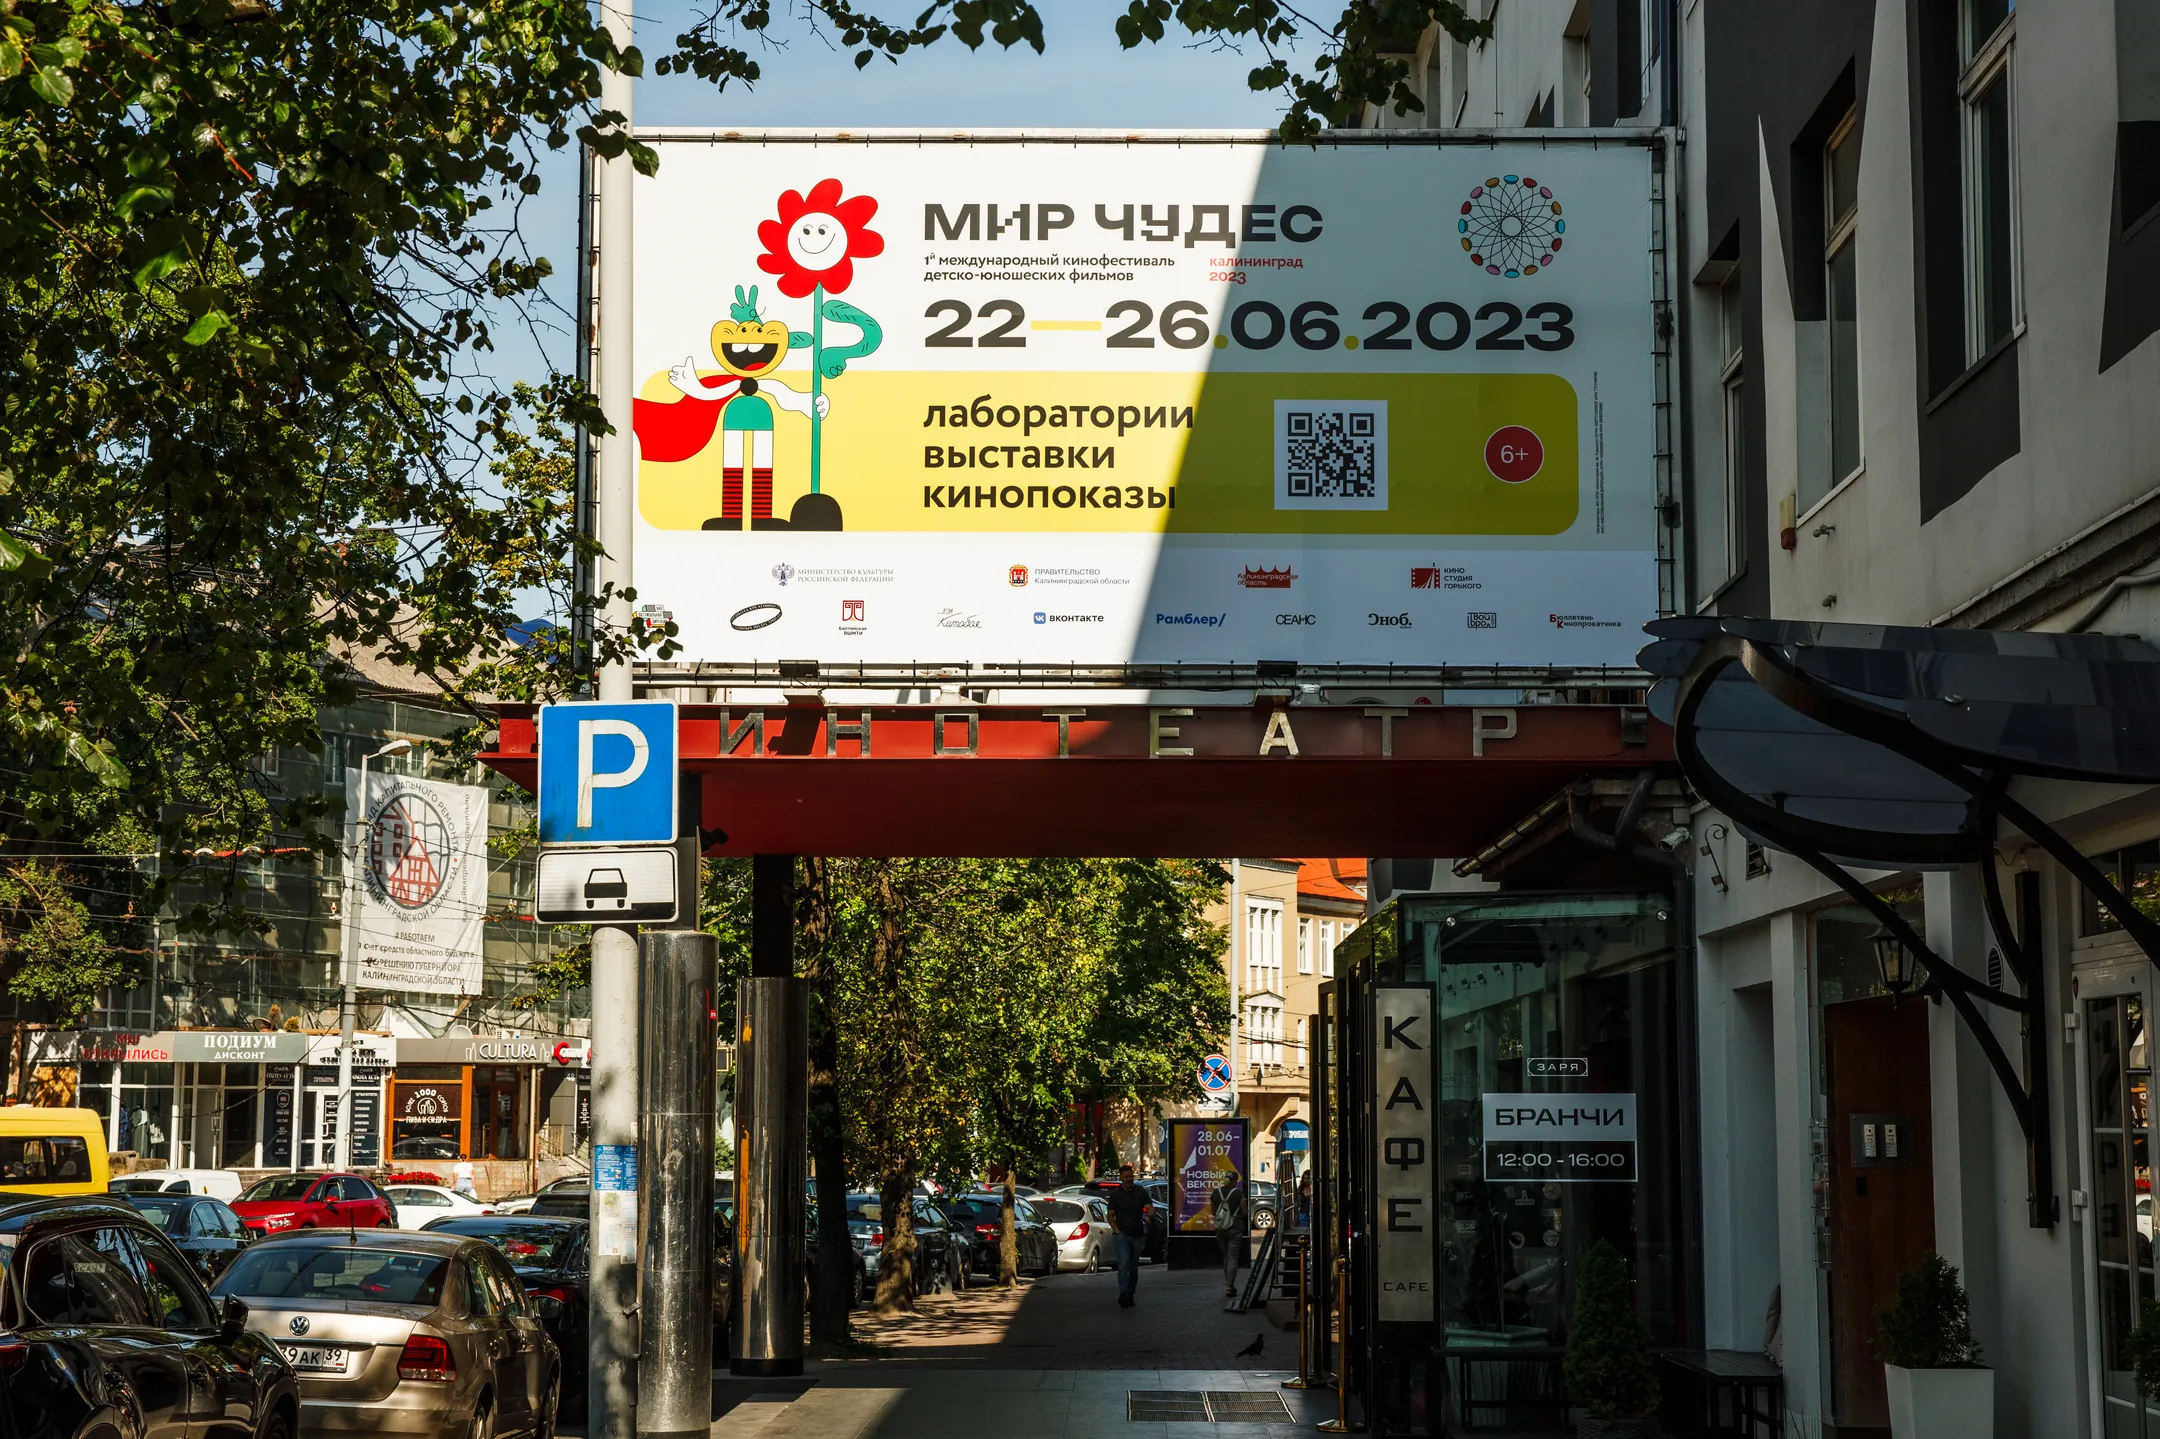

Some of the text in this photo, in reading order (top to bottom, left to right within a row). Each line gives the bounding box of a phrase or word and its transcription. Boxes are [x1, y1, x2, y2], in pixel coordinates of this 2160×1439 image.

[925, 203, 1323, 248] МИР ЧУДЕС
[939, 254, 1059, 268] международный
[1062, 254, 1175, 269] кинофестиваль
[1209, 255, 1304, 269] калининград
[924, 267, 1134, 283] детско-юношеских фильмов
[1209, 271, 1246, 284] 2023
[924, 393, 1194, 437] лаборатории
[924, 445, 1115, 469] выставки
[1500, 444, 1529, 464] 6+
[924, 482, 1176, 509] кинопоказы
[1034, 568, 1101, 576] ПРАВИТЕЛЬСТВО
[1034, 577, 1130, 586] Калининградской области
[1049, 615, 1105, 623] вконтакте
[719, 706, 1518, 758] ИНОТЕАТР
[576, 719, 650, 829] P
[203, 1035, 278, 1051] ПОДИУМ
[84, 1048, 169, 1061] ОТКРЫЛИСЬ
[214, 1051, 266, 1060] ДИСКОНТ
[479, 1042, 537, 1060] CULTURA
[1536, 1063, 1579, 1072] ЗАРЯ
[414, 1088, 438, 1099] 1000
[1382, 1015, 1426, 1232] КАФЕ
[1495, 1108, 1624, 1127] БРАНЧИ
[1496, 1153, 1552, 1167] 12:00
[1568, 1153, 1625, 1167] 16:00
[1383, 1281, 1429, 1292] CAFE
